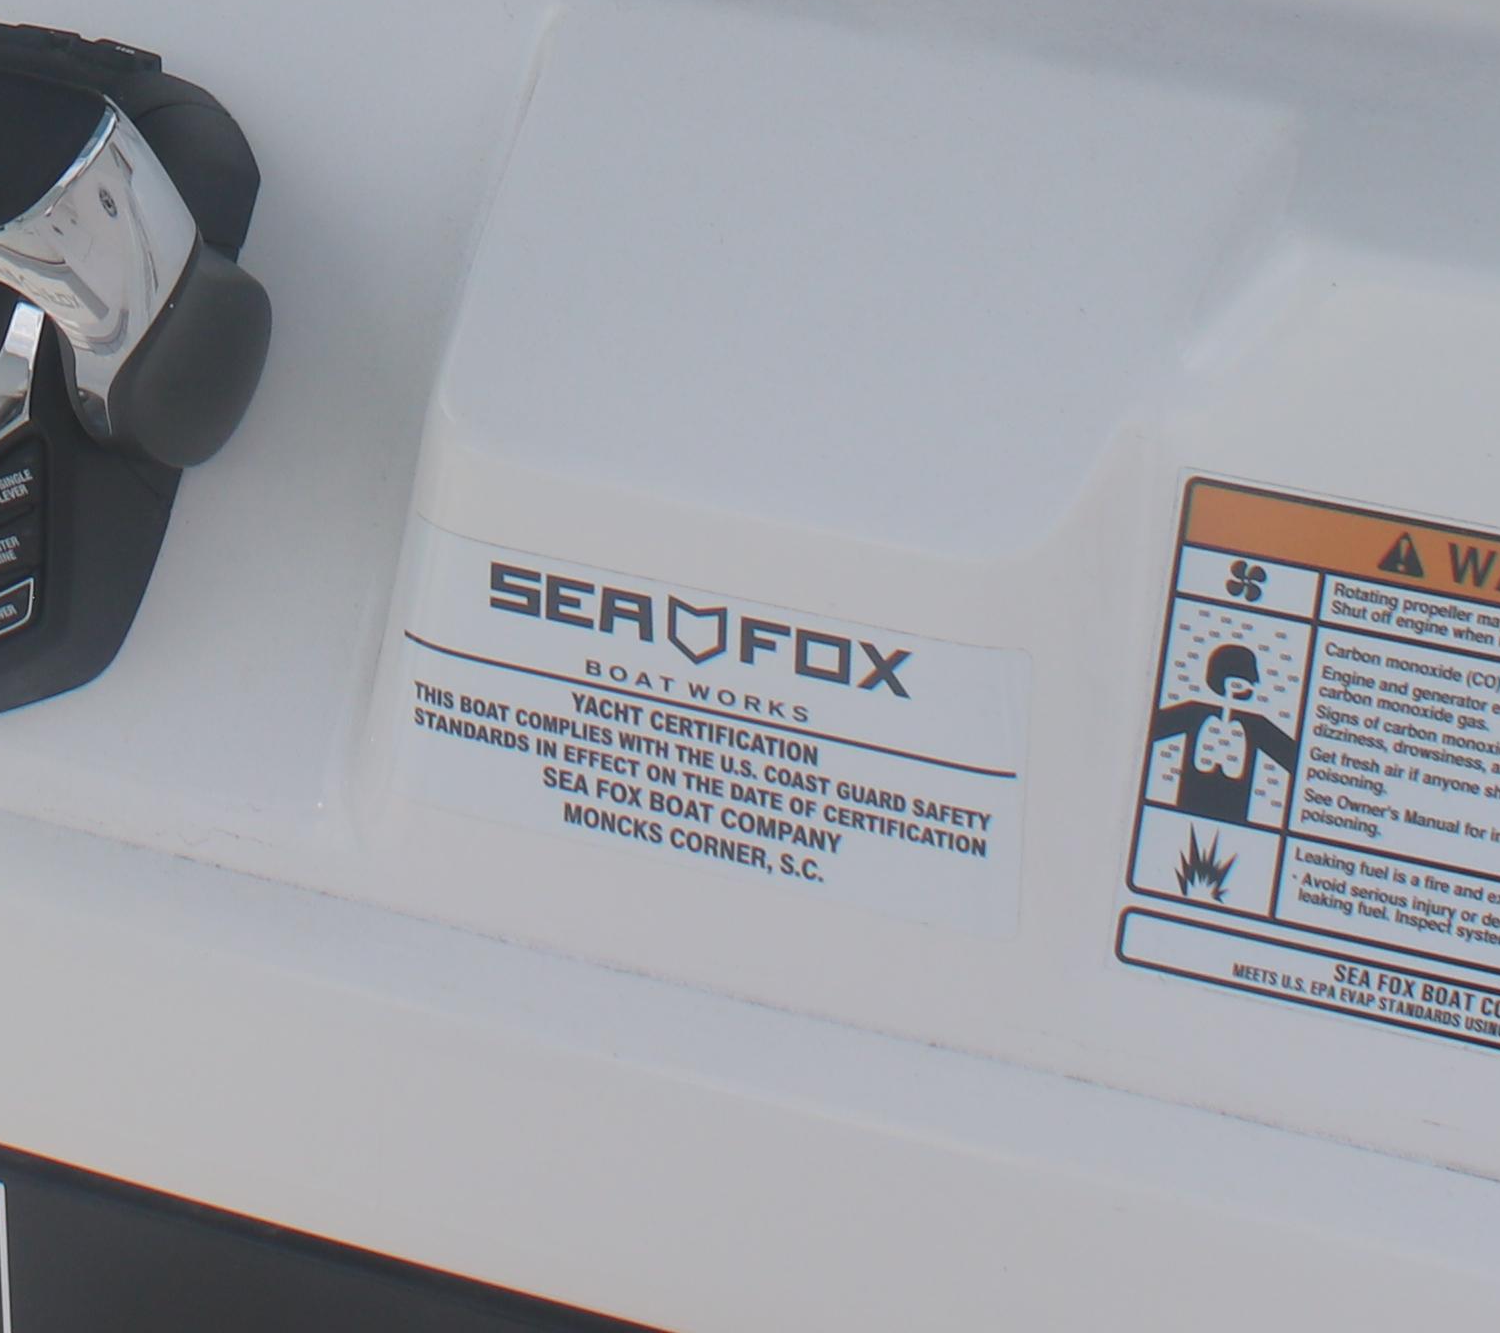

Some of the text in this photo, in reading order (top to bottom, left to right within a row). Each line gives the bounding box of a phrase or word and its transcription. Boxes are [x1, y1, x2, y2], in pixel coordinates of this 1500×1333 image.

[489, 561, 912, 699] SEA FOX
[1330, 599, 1368, 620] Shut
[1370, 609, 1393, 625] off
[1395, 615, 1449, 636] engine
[1451, 626, 1494, 645] when
[1333, 581, 1399, 612] Rotating
[1402, 598, 1473, 622] propeller
[585, 659, 808, 723] BOAT WORKS
[1324, 641, 1381, 666] Carbon
[1384, 656, 1462, 682] monoxide
[414, 680, 991, 831] THIS BOAT COMPLIES WITH THE U.S. COAST GUARD SAFETY
[571, 691, 818, 766] YACHT CERTIFICATION
[414, 706, 986, 857] STANDARDS IN EFFECT ON THE DATE OF CERTIFICATION
[542, 765, 841, 853] SEA FOX BOAT COMPANY
[563, 801, 823, 882] MONCKS CORNER, S.C.
[1232, 962, 1278, 986] MEETS
[1280, 974, 1305, 992] U.S.
[1309, 980, 1335, 999] EPA
[1339, 986, 1375, 1007] EVAP
[1378, 996, 1461, 1028] STANDARDS
[1333, 963, 1370, 989] SEA
[1376, 972, 1415, 998] FOX
[1420, 982, 1475, 1011] BOAT
